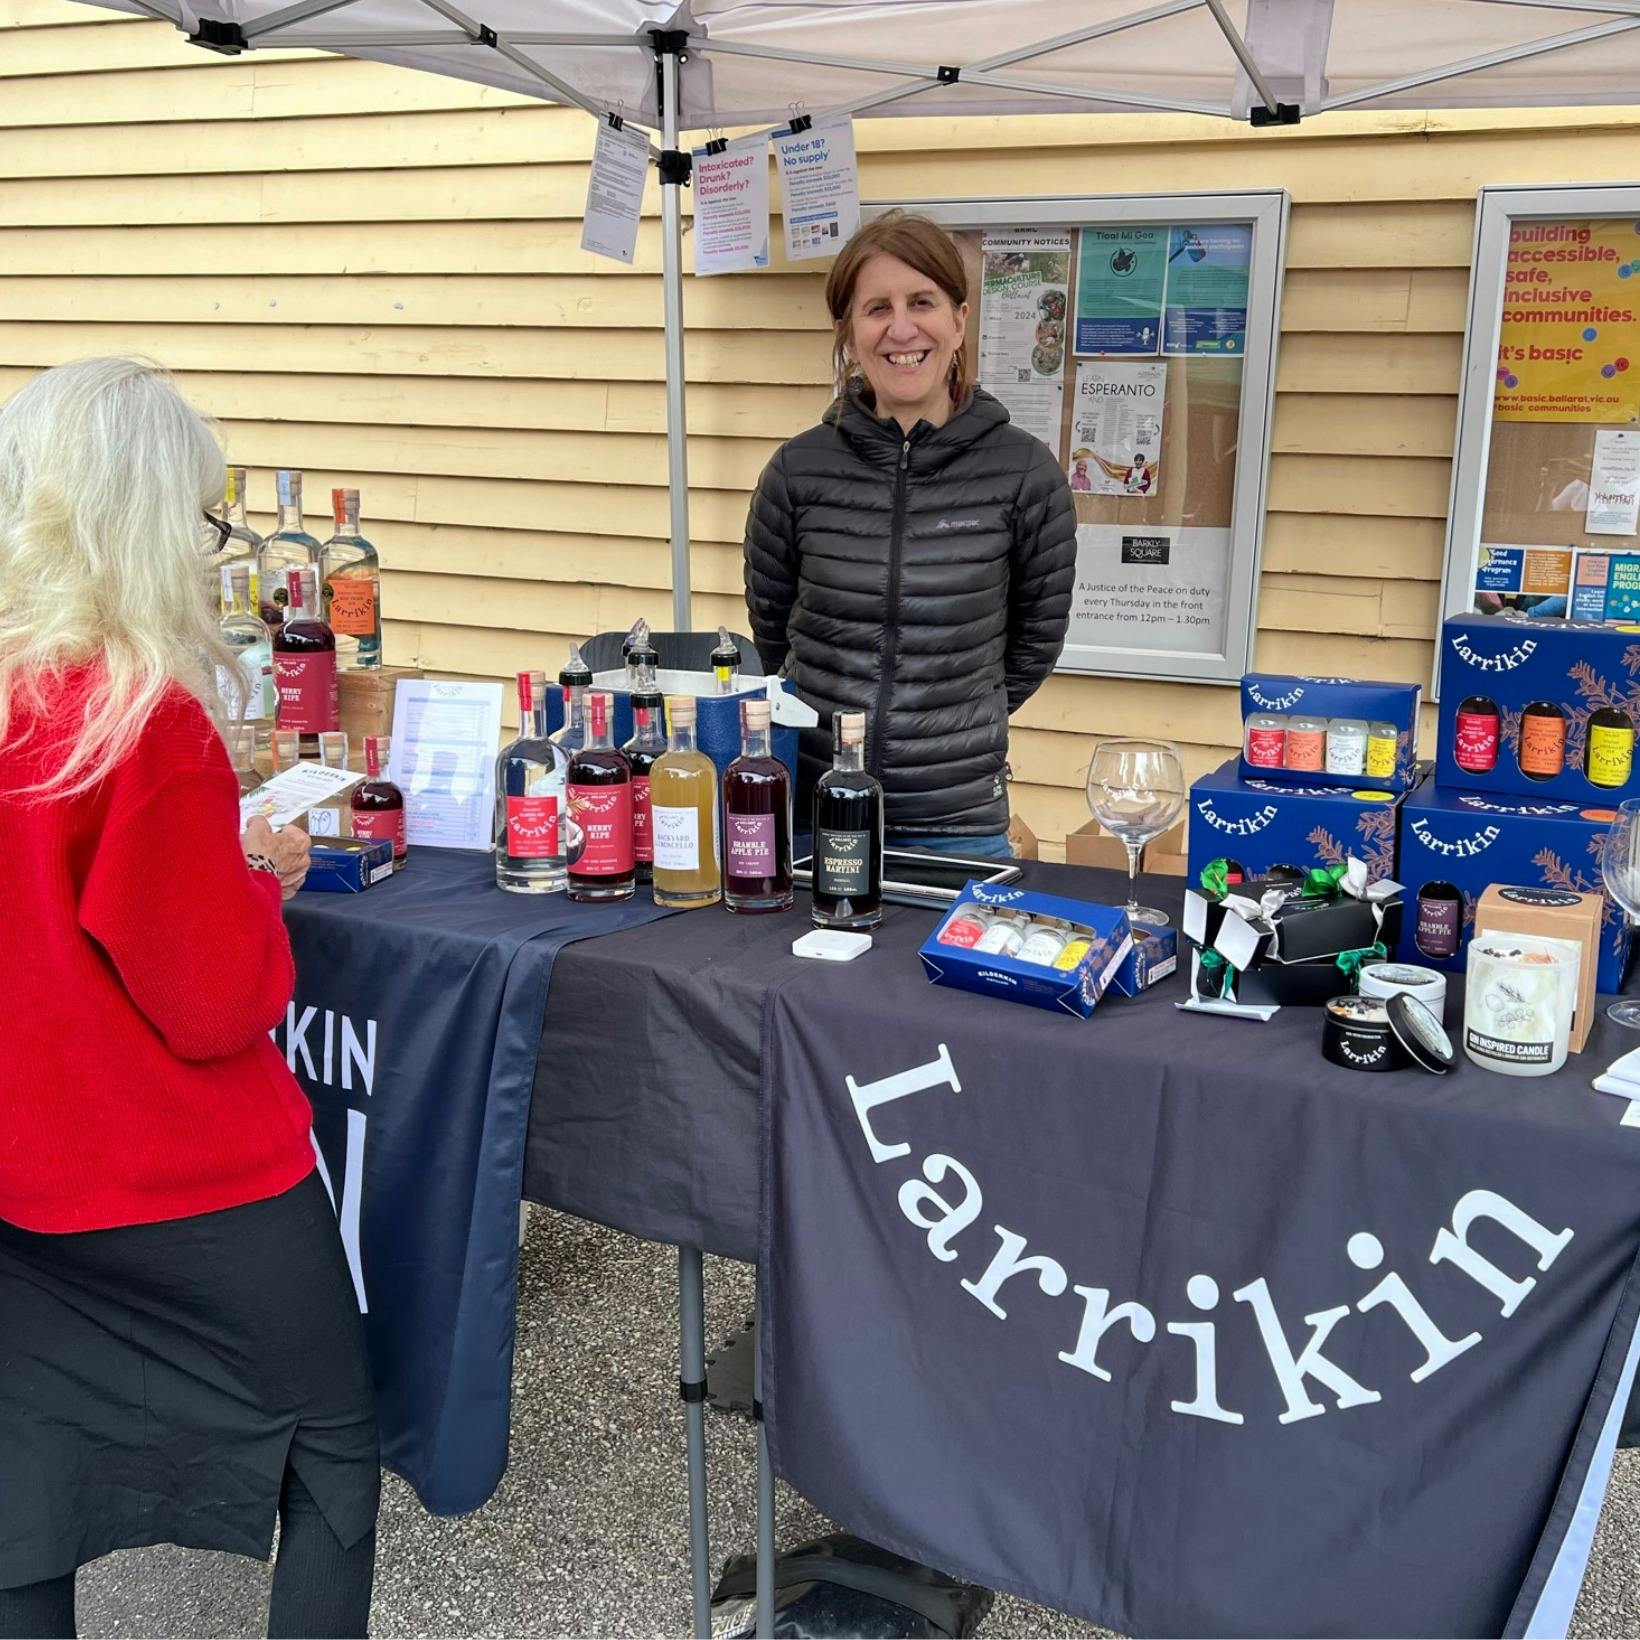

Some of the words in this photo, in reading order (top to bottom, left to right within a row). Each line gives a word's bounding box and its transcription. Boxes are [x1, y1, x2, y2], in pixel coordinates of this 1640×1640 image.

[781, 142, 810, 154] Under
[811, 138, 825, 149] 18?
[698, 155, 754, 173] Intoxicated?
[783, 157, 796, 166] No
[699, 171, 731, 184] Drunk?
[699, 179, 750, 195] Disorderly?
[1034, 238, 1070, 246] NOTICES
[1509, 225, 1592, 244] building
[1507, 246, 1621, 264] accessible,
[1505, 267, 1553, 285] safe,
[1504, 287, 1593, 303] inclusive
[1015, 311, 1036, 320] 2024
[1502, 306, 1637, 323] communities.
[1498, 344, 1525, 361] it's
[1529, 345, 1583, 364] basic
[1081, 383, 1156, 397] ESPERANTO
[1132, 539, 1160, 547] BARKLY
[1130, 548, 1162, 559] SQUARE
[1079, 582, 1086, 590] A
[1087, 583, 1116, 592] Justice
[1118, 584, 1128, 592] of
[1130, 584, 1145, 593] the
[1147, 585, 1174, 594] Peace
[1175, 587, 1188, 595] on
[1190, 587, 1210, 597] duty
[1084, 599, 1108, 608] every
[1110, 598, 1151, 609] Thursday
[1152, 600, 1161, 608] in
[1163, 600, 1178, 609] the
[1180, 600, 1204, 610] front
[1076, 612, 1114, 621] entrance
[1116, 612, 1138, 621] from
[1140, 613, 1166, 624] 12pm
[1176, 615, 1210, 625] 1.30pm
[1452, 633, 1538, 672] Larrikin
[1248, 683, 1305, 711] Larrikin
[1197, 798, 1278, 835] Larrikin
[509, 815, 557, 837] Larrikin
[587, 824, 613, 832] BERRY
[735, 821, 762, 834] Larrikin
[733, 840, 766, 848] BRAMBLE
[829, 837, 858, 852] Larrikin
[1410, 817, 1501, 858] Larrikin
[731, 847, 752, 856] APPLE
[754, 848, 769, 856] PIE
[824, 856, 863, 866] ESPRESSO
[825, 864, 860, 874] MARTINI
[972, 883, 1025, 903] Larrikin
[977, 970, 1018, 986] KILDERKIN
[268, 999, 377, 1097] KIN
[1340, 1040, 1387, 1064] Larrikin
[1480, 1037, 1516, 1054] INSPIRED
[1516, 1045, 1549, 1055] CANDLE
[845, 1043, 1575, 1426] Larrikin
